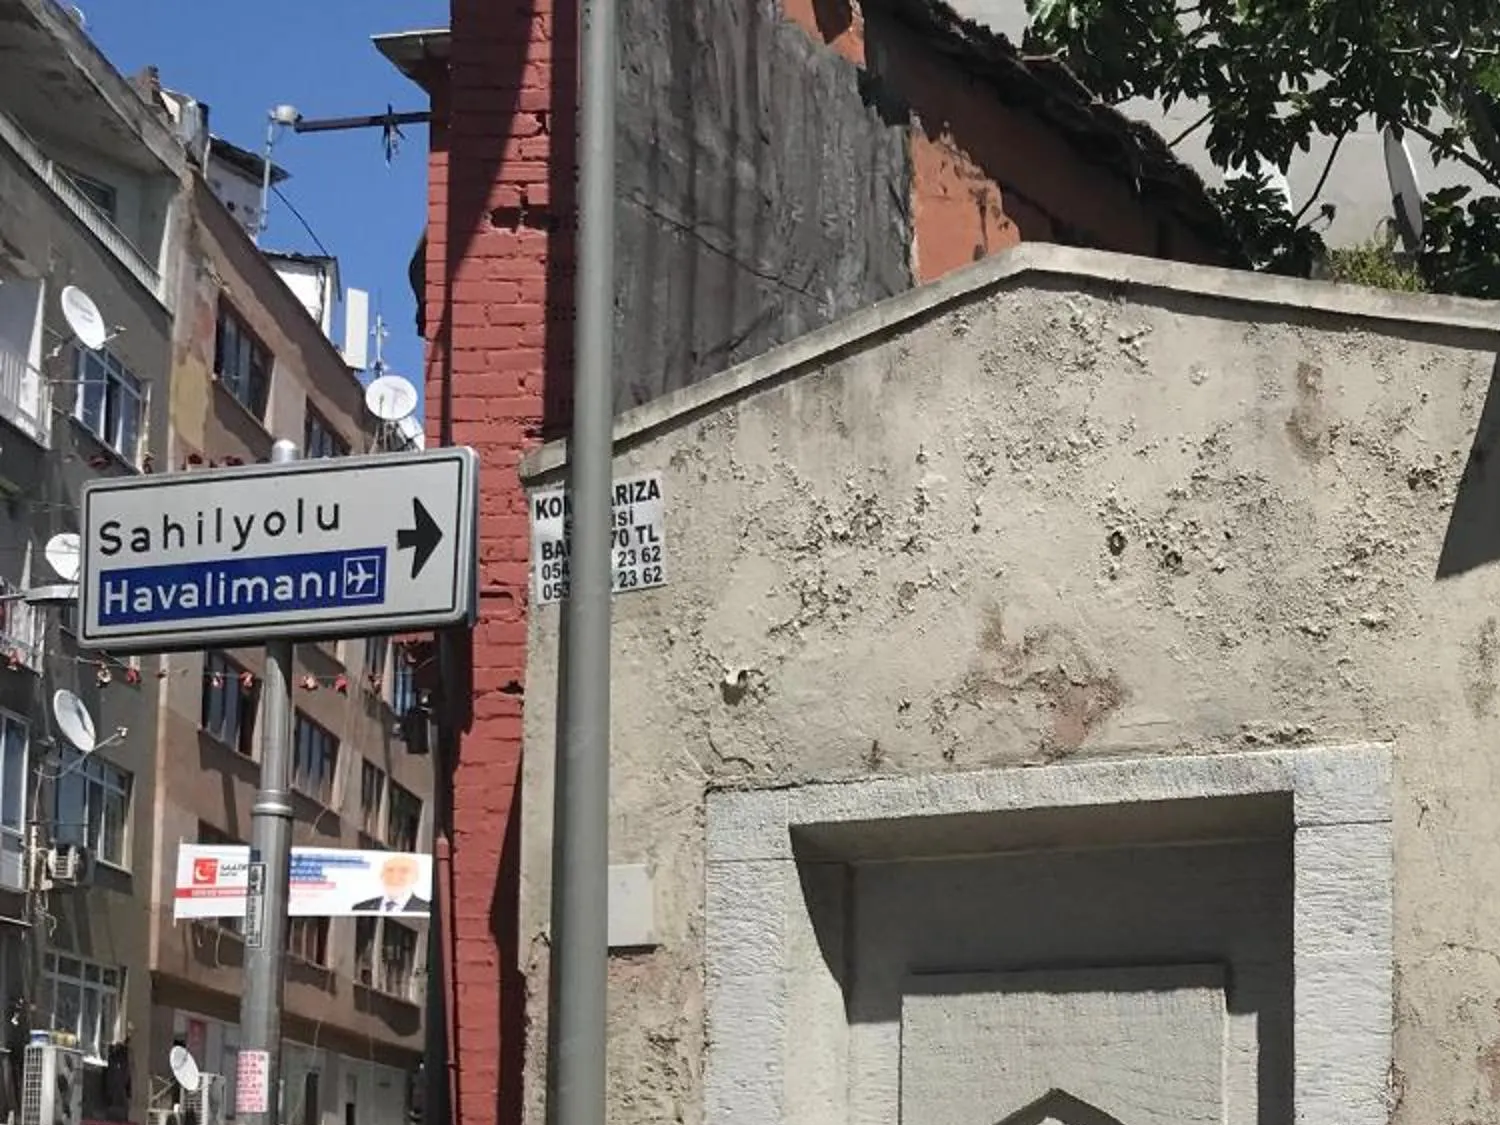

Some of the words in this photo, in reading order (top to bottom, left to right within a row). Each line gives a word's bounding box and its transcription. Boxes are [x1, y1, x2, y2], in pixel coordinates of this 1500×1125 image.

[612, 479, 660, 506] RIZA
[99, 498, 341, 557] Sahilyolu
[635, 524, 659, 545] TL
[617, 549, 637, 569] 23
[641, 545, 662, 563] 62
[618, 569, 637, 589] 23
[643, 566, 662, 585] 62
[104, 569, 337, 615] Havalimanı
